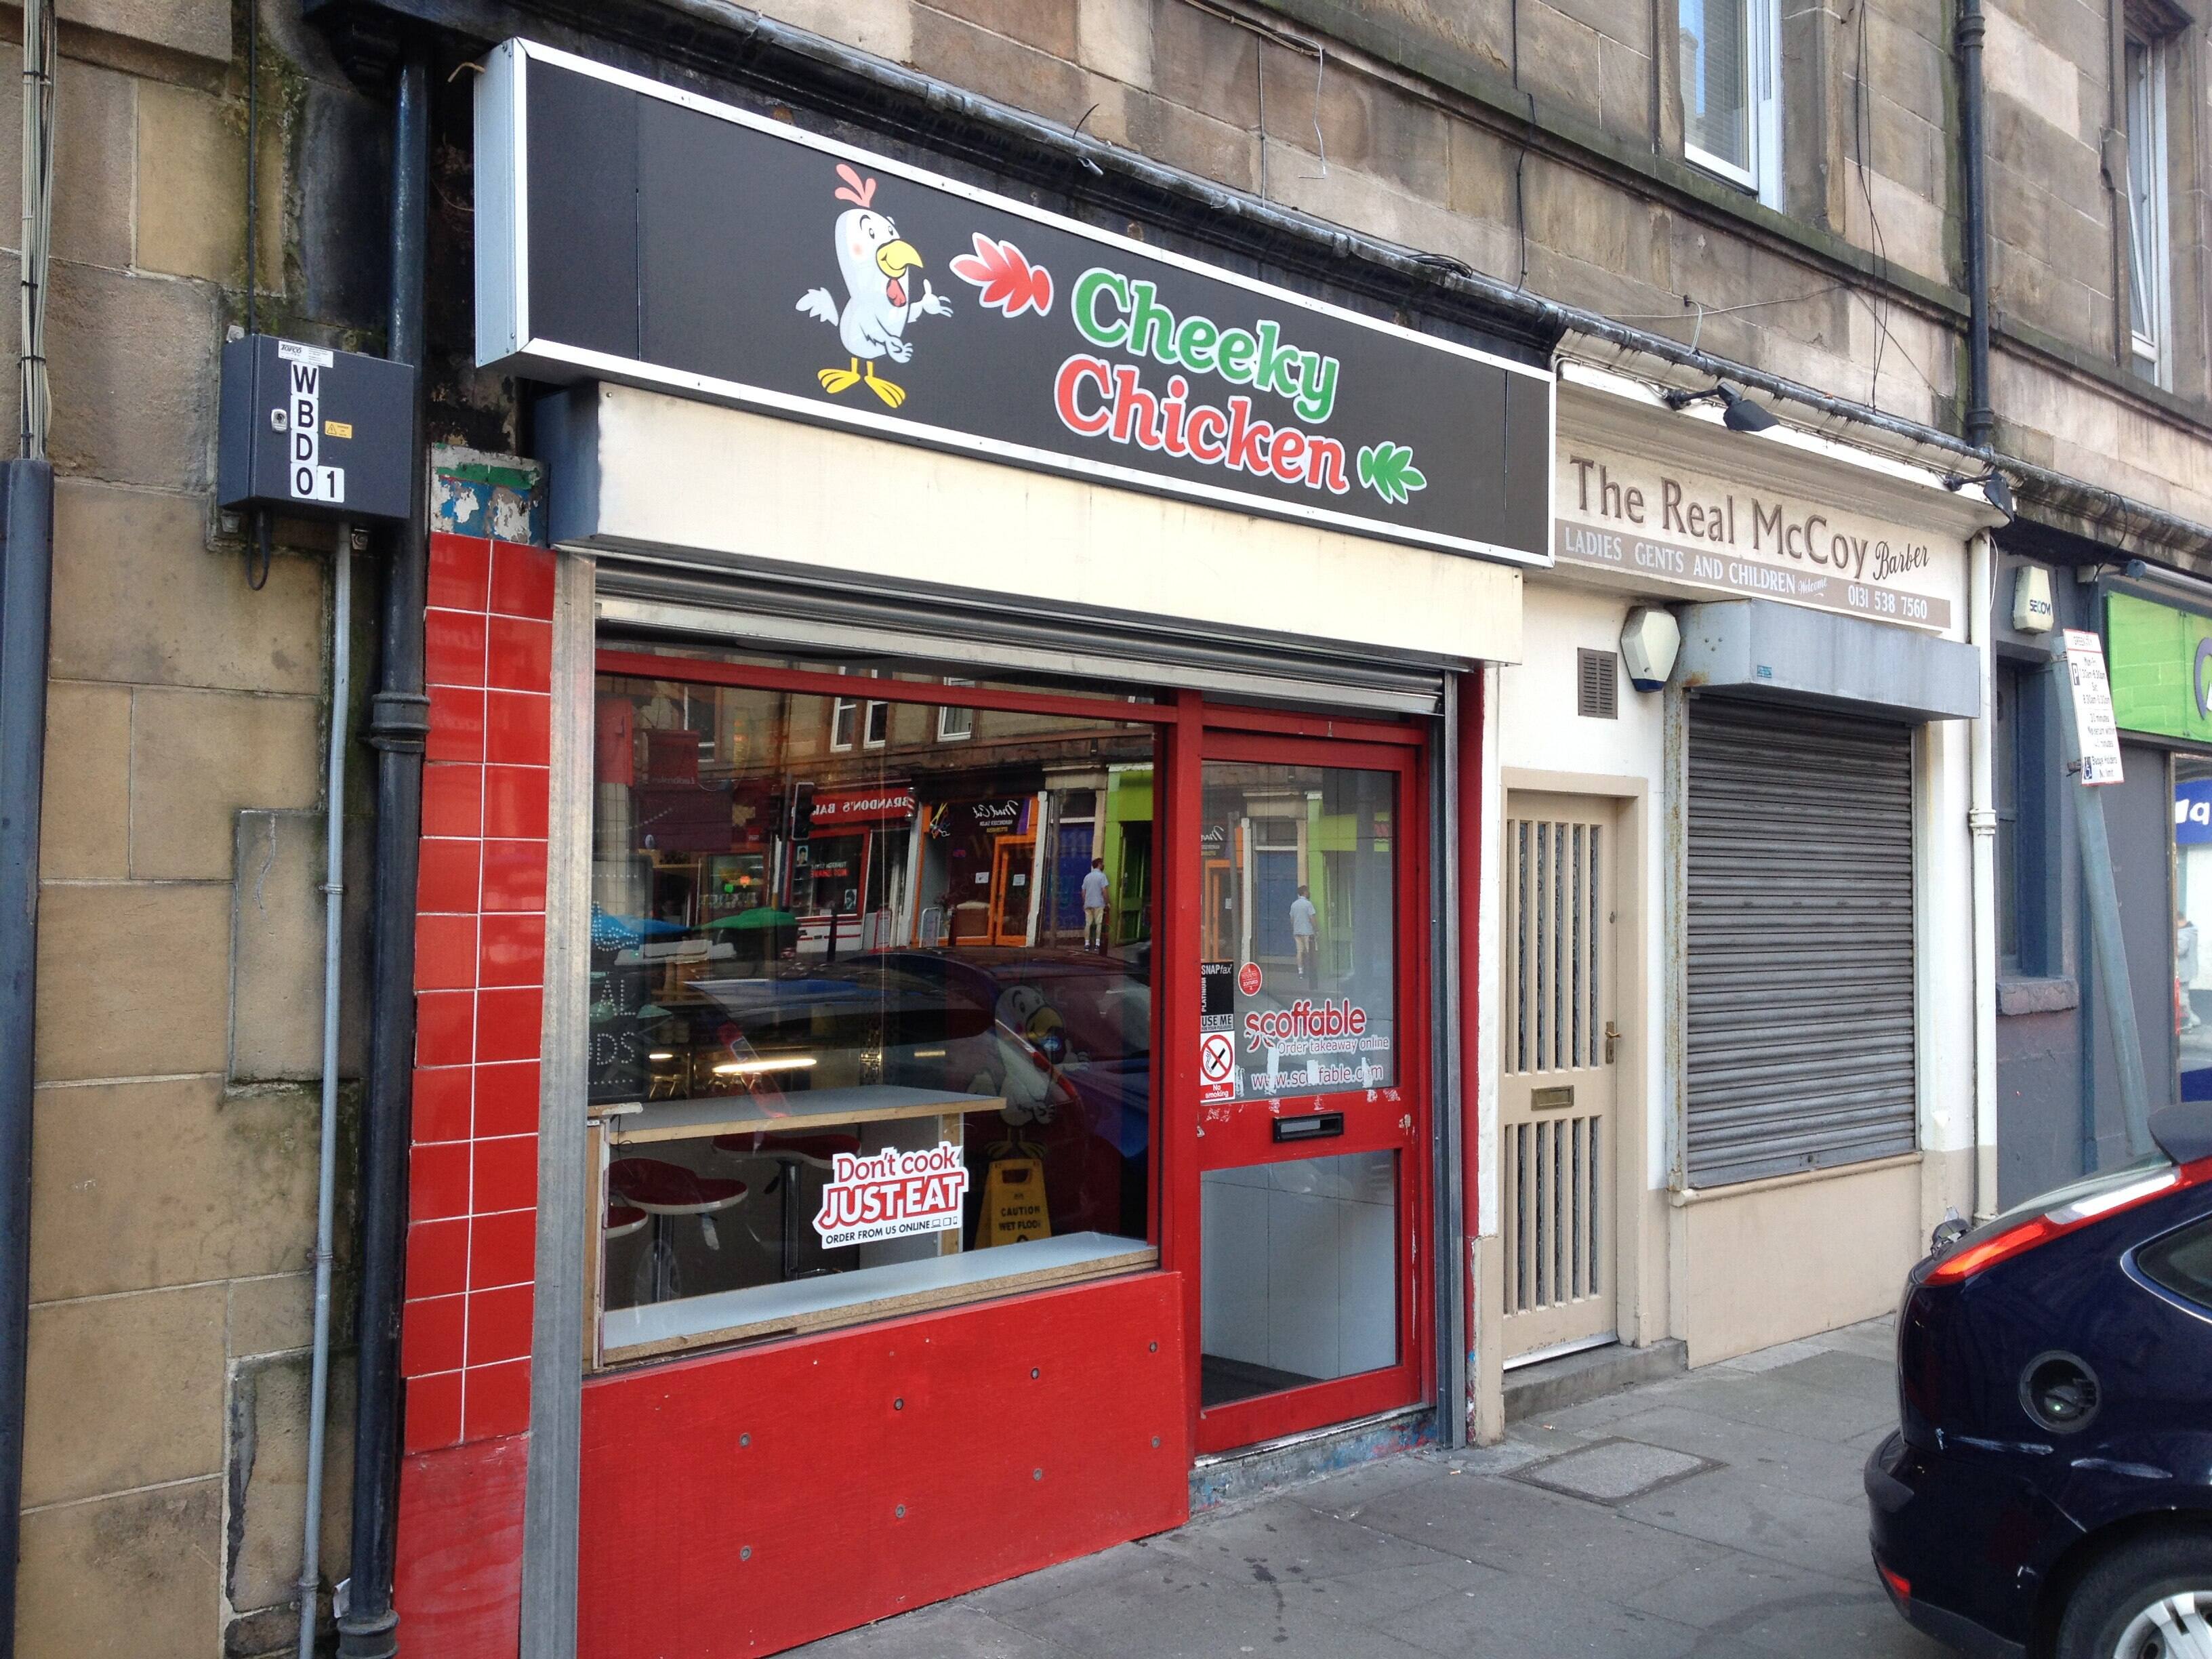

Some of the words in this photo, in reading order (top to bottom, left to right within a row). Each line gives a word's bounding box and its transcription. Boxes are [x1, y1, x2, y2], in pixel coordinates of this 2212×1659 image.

[1072, 268, 1339, 423] Cheeky
[1054, 354, 1350, 494] Chicken
[1570, 454, 1644, 524] The
[1661, 476, 1734, 544] Real
[1751, 497, 1868, 583] McCoy
[1872, 540, 1930, 581] Barber
[1564, 527, 1622, 562] LADIES
[1635, 541, 1685, 573] GENTS
[1694, 554, 1723, 580] AND
[1729, 562, 1796, 594] CHILDREN
[1797, 577, 1828, 597] Welcome
[1847, 584, 1869, 608] 0131
[1874, 590, 1896, 613] 538
[1900, 596, 1928, 619] 7560
[2030, 599, 2051, 615] SECOM
[1202, 1016, 1217, 1026] USE
[1219, 1015, 1232, 1025] ME
[1245, 999, 1366, 1040] scoffable
[1277, 1041, 1307, 1054] Order
[1310, 1038, 1357, 1052] takeaway
[1359, 1036, 1389, 1048] online
[837, 1152, 896, 1183] Don't
[901, 1145, 956, 1174] cook
[821, 1183, 901, 1226] JUST
[903, 1175, 962, 1214] EAT
[1000, 1206, 1041, 1217] CAUTION
[825, 1231, 855, 1244] ORDER
[858, 1227, 883, 1240] FROM
[885, 1225, 896, 1235] US
[899, 1220, 930, 1233] ONLINE
[998, 1221, 1016, 1231] WET
